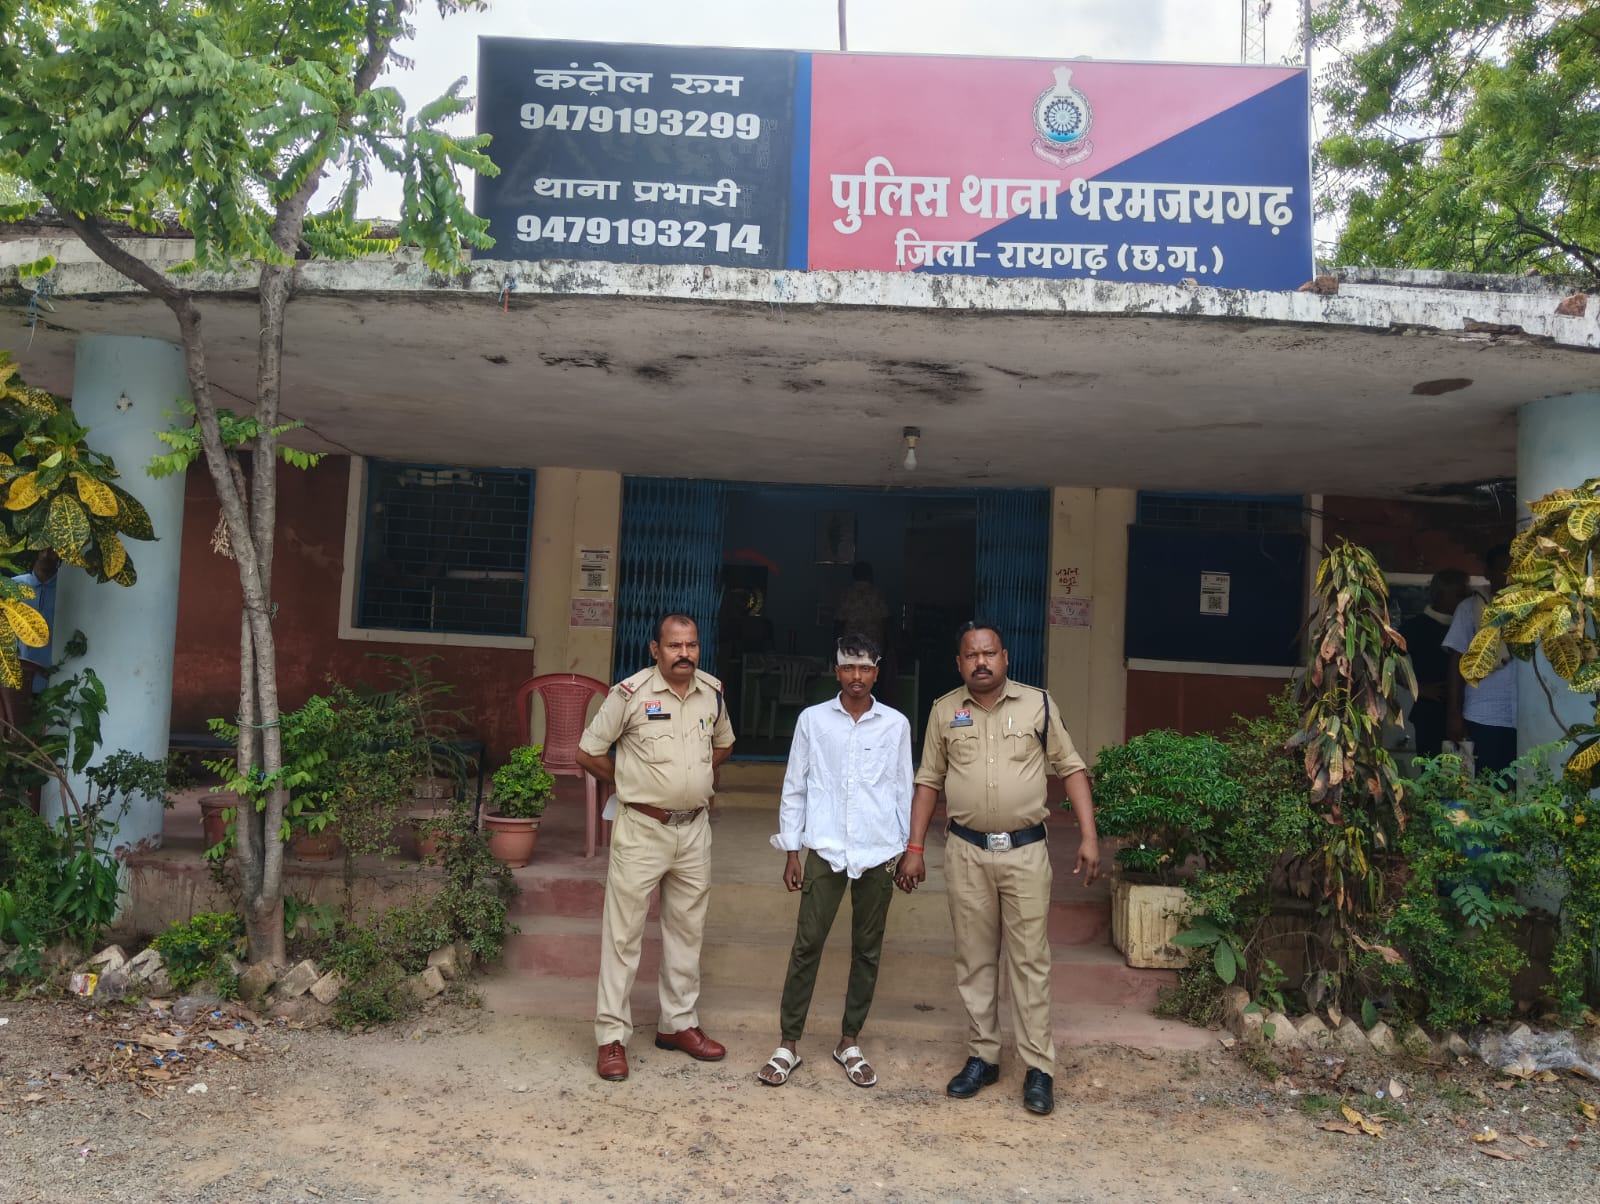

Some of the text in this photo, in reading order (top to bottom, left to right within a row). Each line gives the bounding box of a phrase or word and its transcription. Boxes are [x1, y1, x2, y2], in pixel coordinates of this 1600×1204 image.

[520, 103, 760, 140] 9479193299
[534, 178, 741, 207] थाना प्रभारी
[830, 156, 1293, 235] पुलिस थाना धरमजयगढ़
[517, 215, 762, 254] 9479193214
[895, 228, 1223, 275] जिला- रायगढ़ (छ.ग.)
